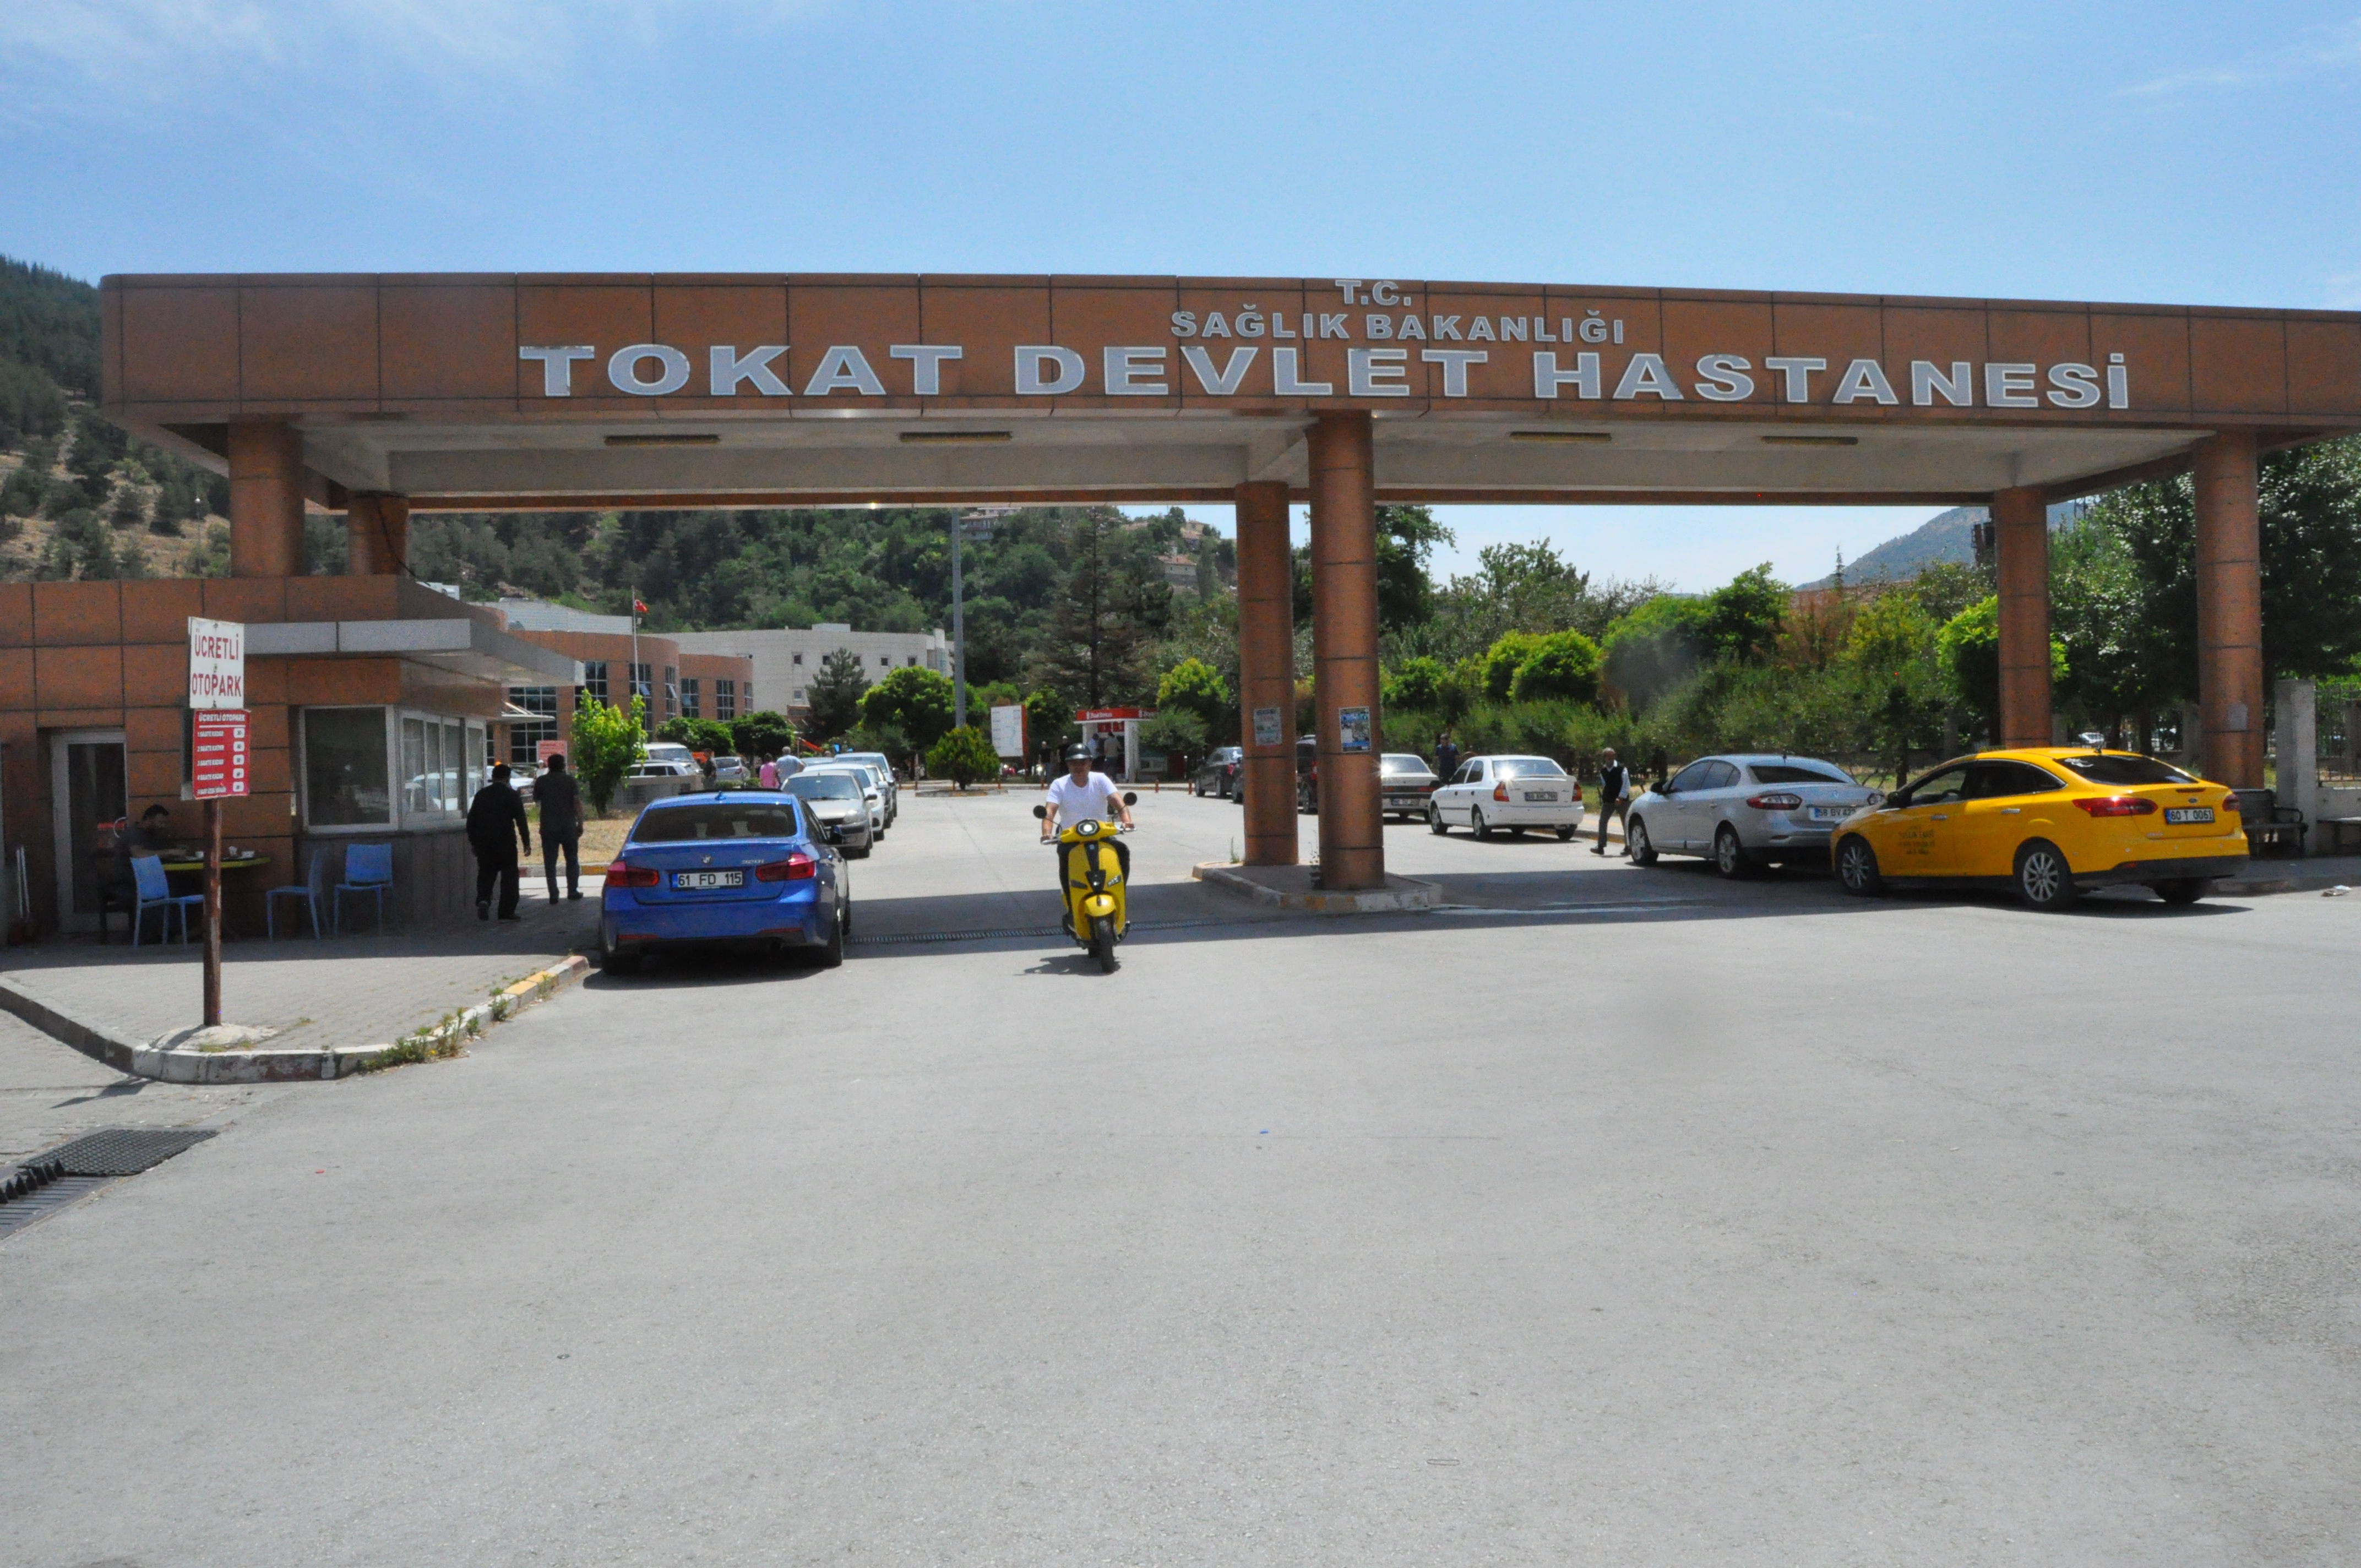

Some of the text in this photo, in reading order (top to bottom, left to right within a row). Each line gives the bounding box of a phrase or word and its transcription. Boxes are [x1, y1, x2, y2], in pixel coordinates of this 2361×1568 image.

[1335, 280, 1411, 307] T.C.
[1171, 304, 1623, 345] SAĞLIK BAKANLIĞI
[519, 344, 2129, 410] TOKAT DEVLET HASTANESİ
[195, 628, 238, 660] ÜCRETLİ
[192, 673, 242, 697] OTOPARK
[222, 714, 246, 722] OTOPARK
[2171, 810, 2181, 820] 60
[2184, 810, 2188, 820] T
[678, 873, 742, 886] 61 FD 115
